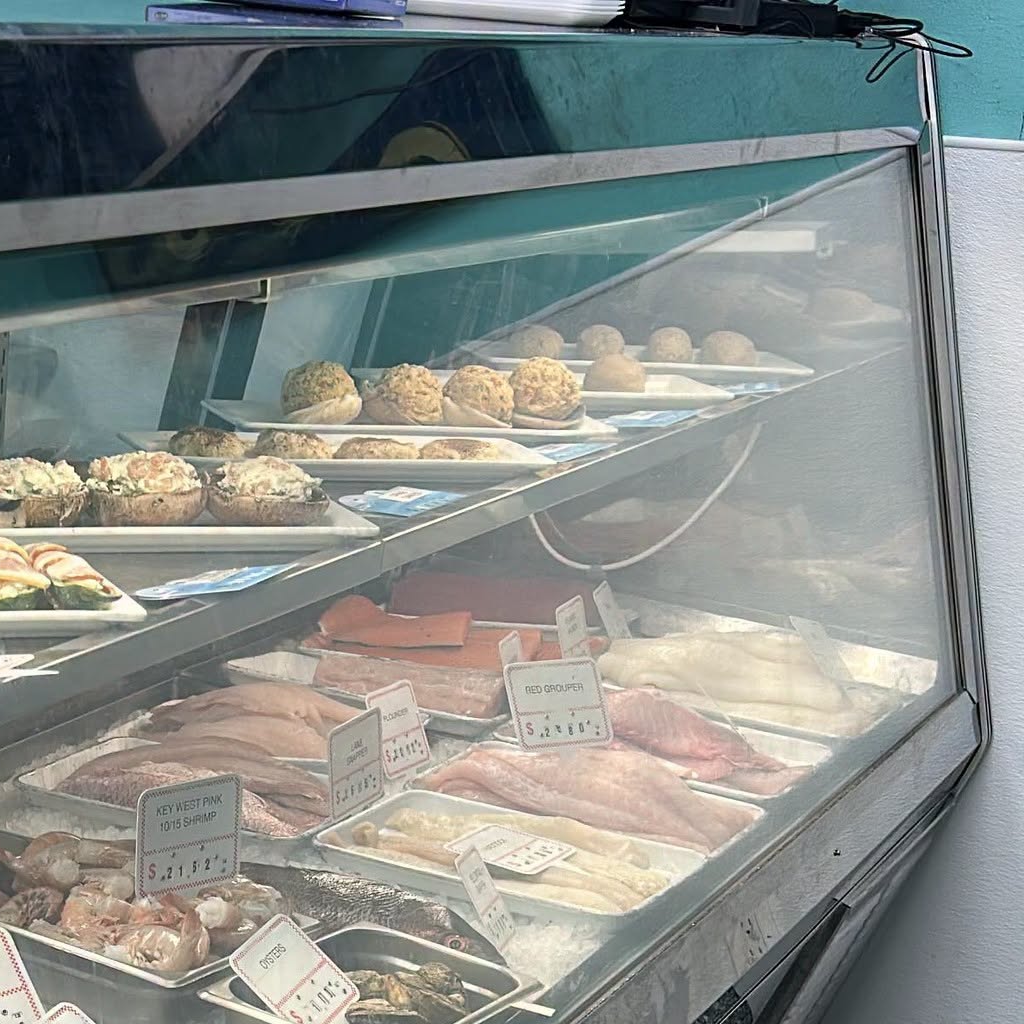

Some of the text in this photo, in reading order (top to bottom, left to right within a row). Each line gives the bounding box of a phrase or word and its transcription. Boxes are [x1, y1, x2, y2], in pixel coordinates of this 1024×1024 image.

[525, 682, 584, 695] RED GROUPER
[156, 794, 223, 817] KEY WEST PINK
[160, 811, 217, 832] 10/15 SHRIMP
[259, 943, 287, 970] OYSTERS
